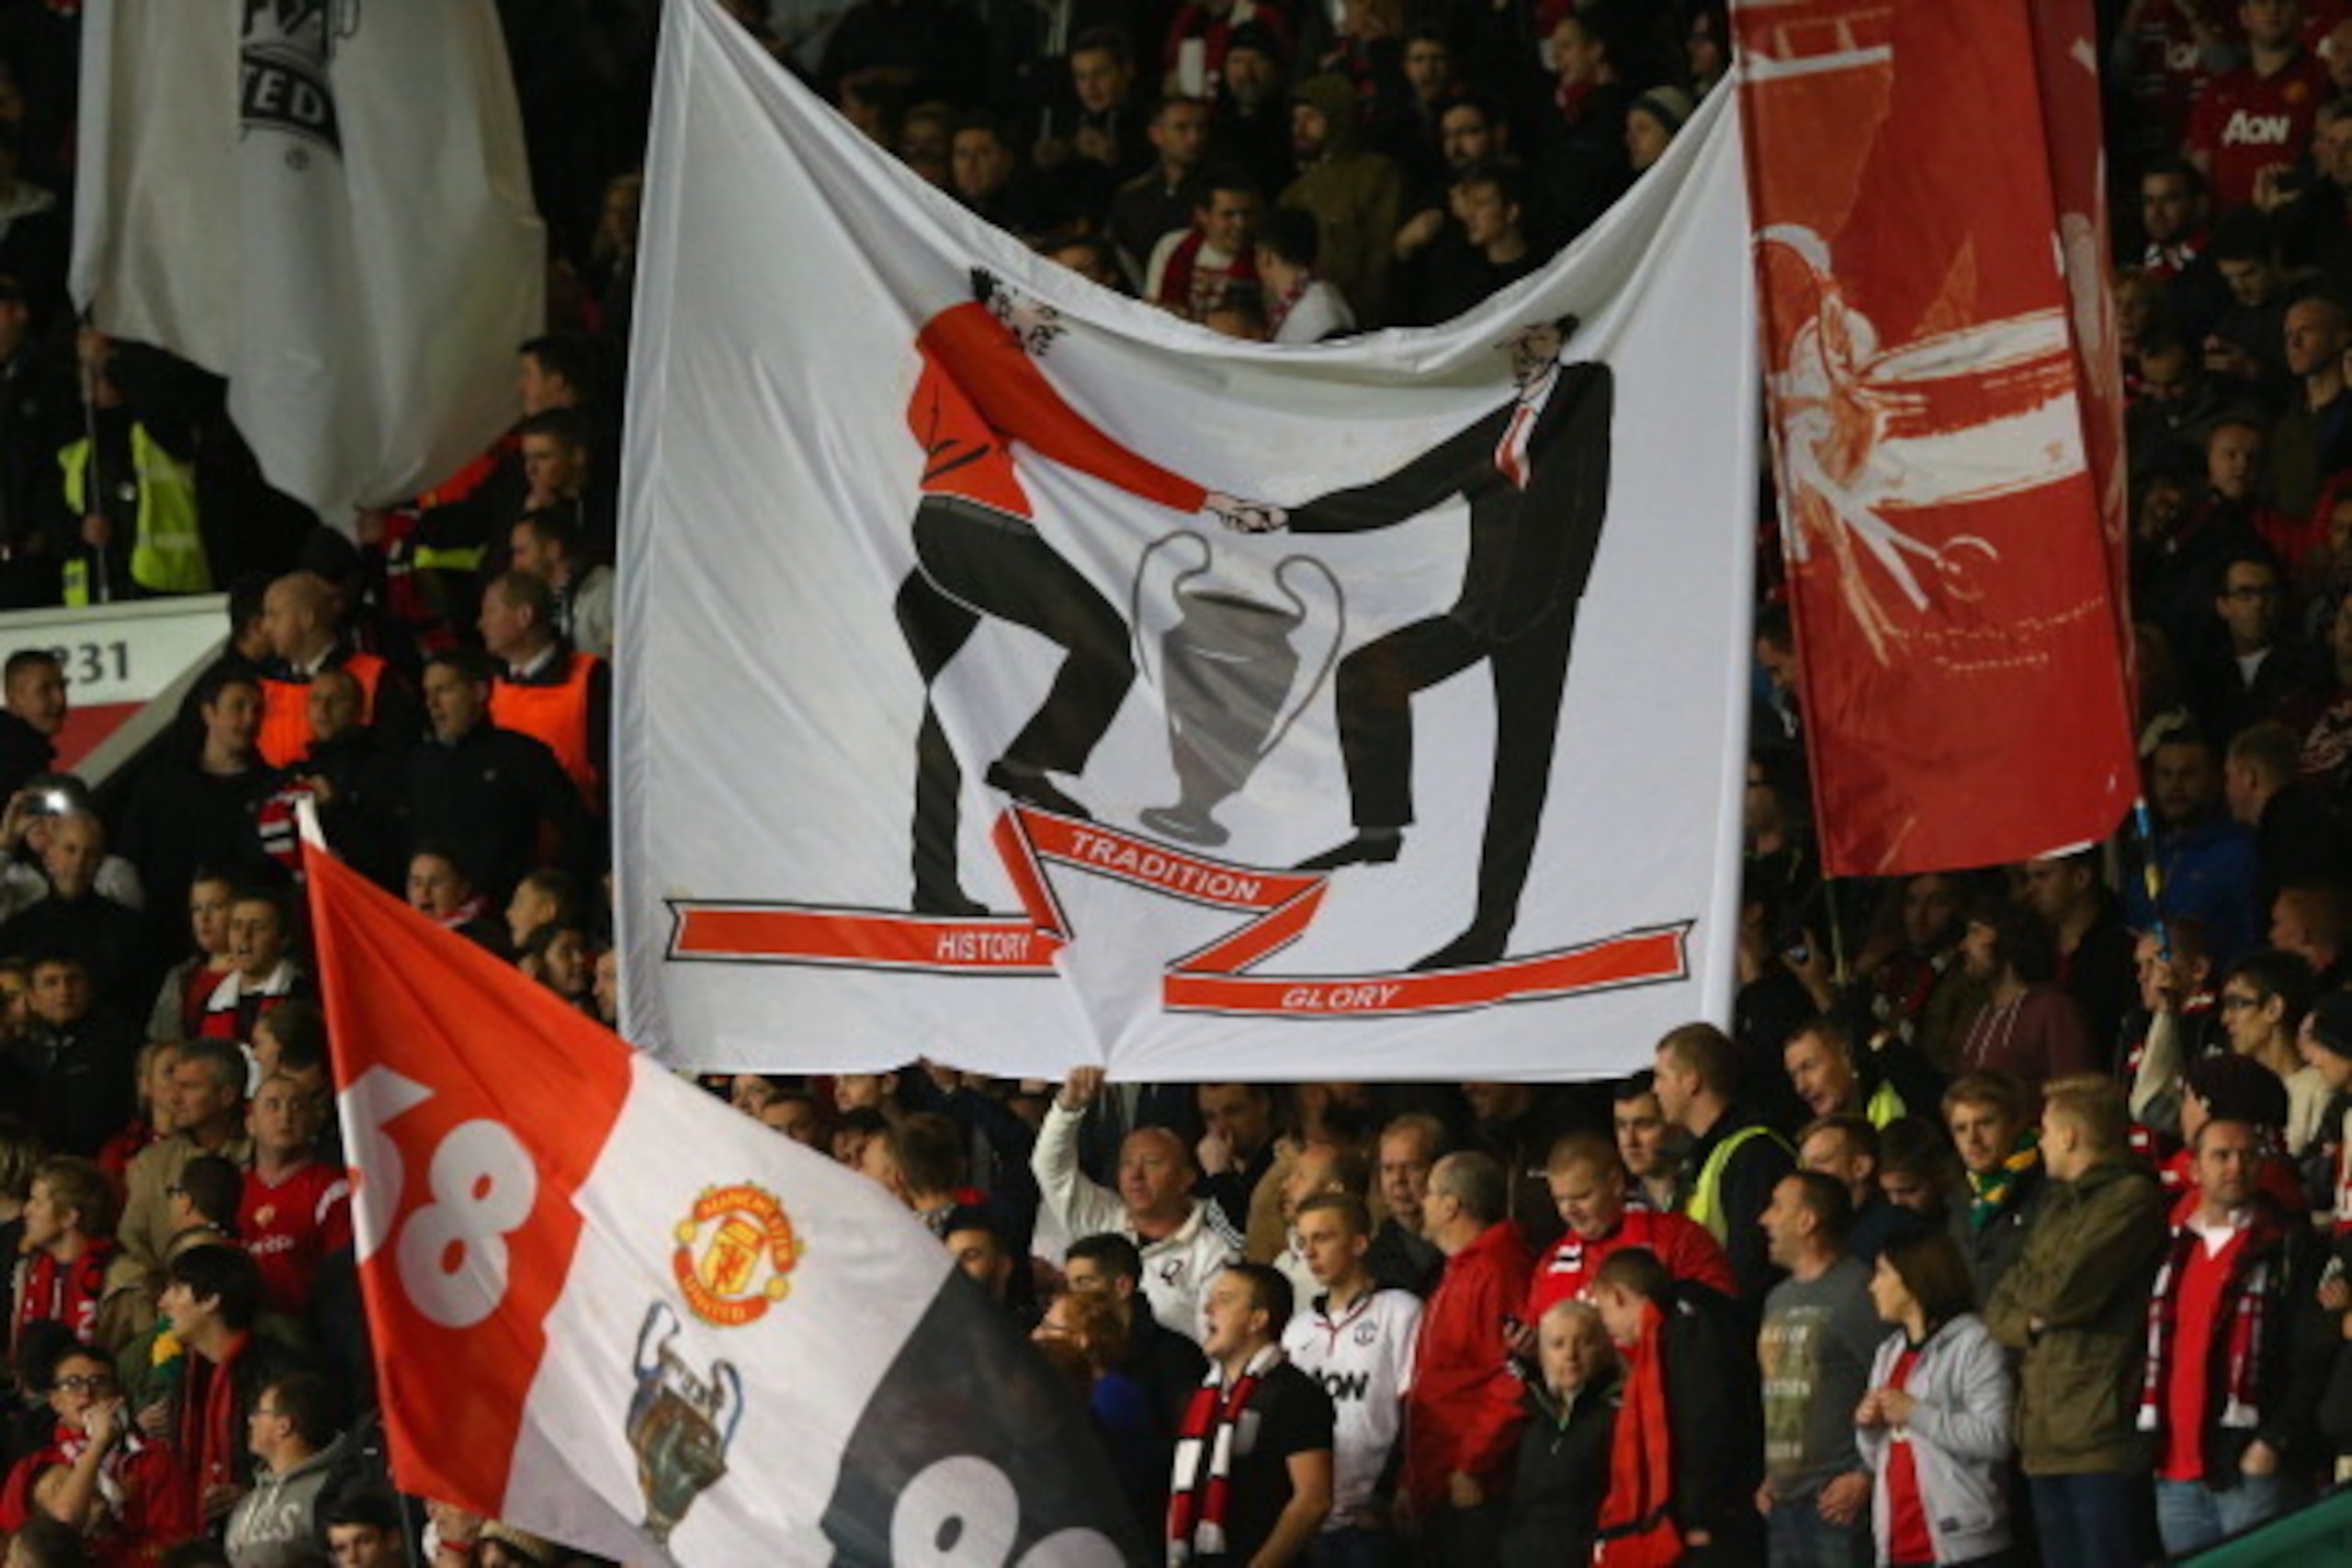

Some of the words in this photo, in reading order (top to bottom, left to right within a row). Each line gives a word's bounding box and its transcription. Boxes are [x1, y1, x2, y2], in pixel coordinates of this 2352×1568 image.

[2221, 108, 2290, 147] AON
[1071, 829, 1261, 901] TRADITION
[936, 931, 1031, 960] HISTORY
[1281, 983, 1405, 1010] GLORY
